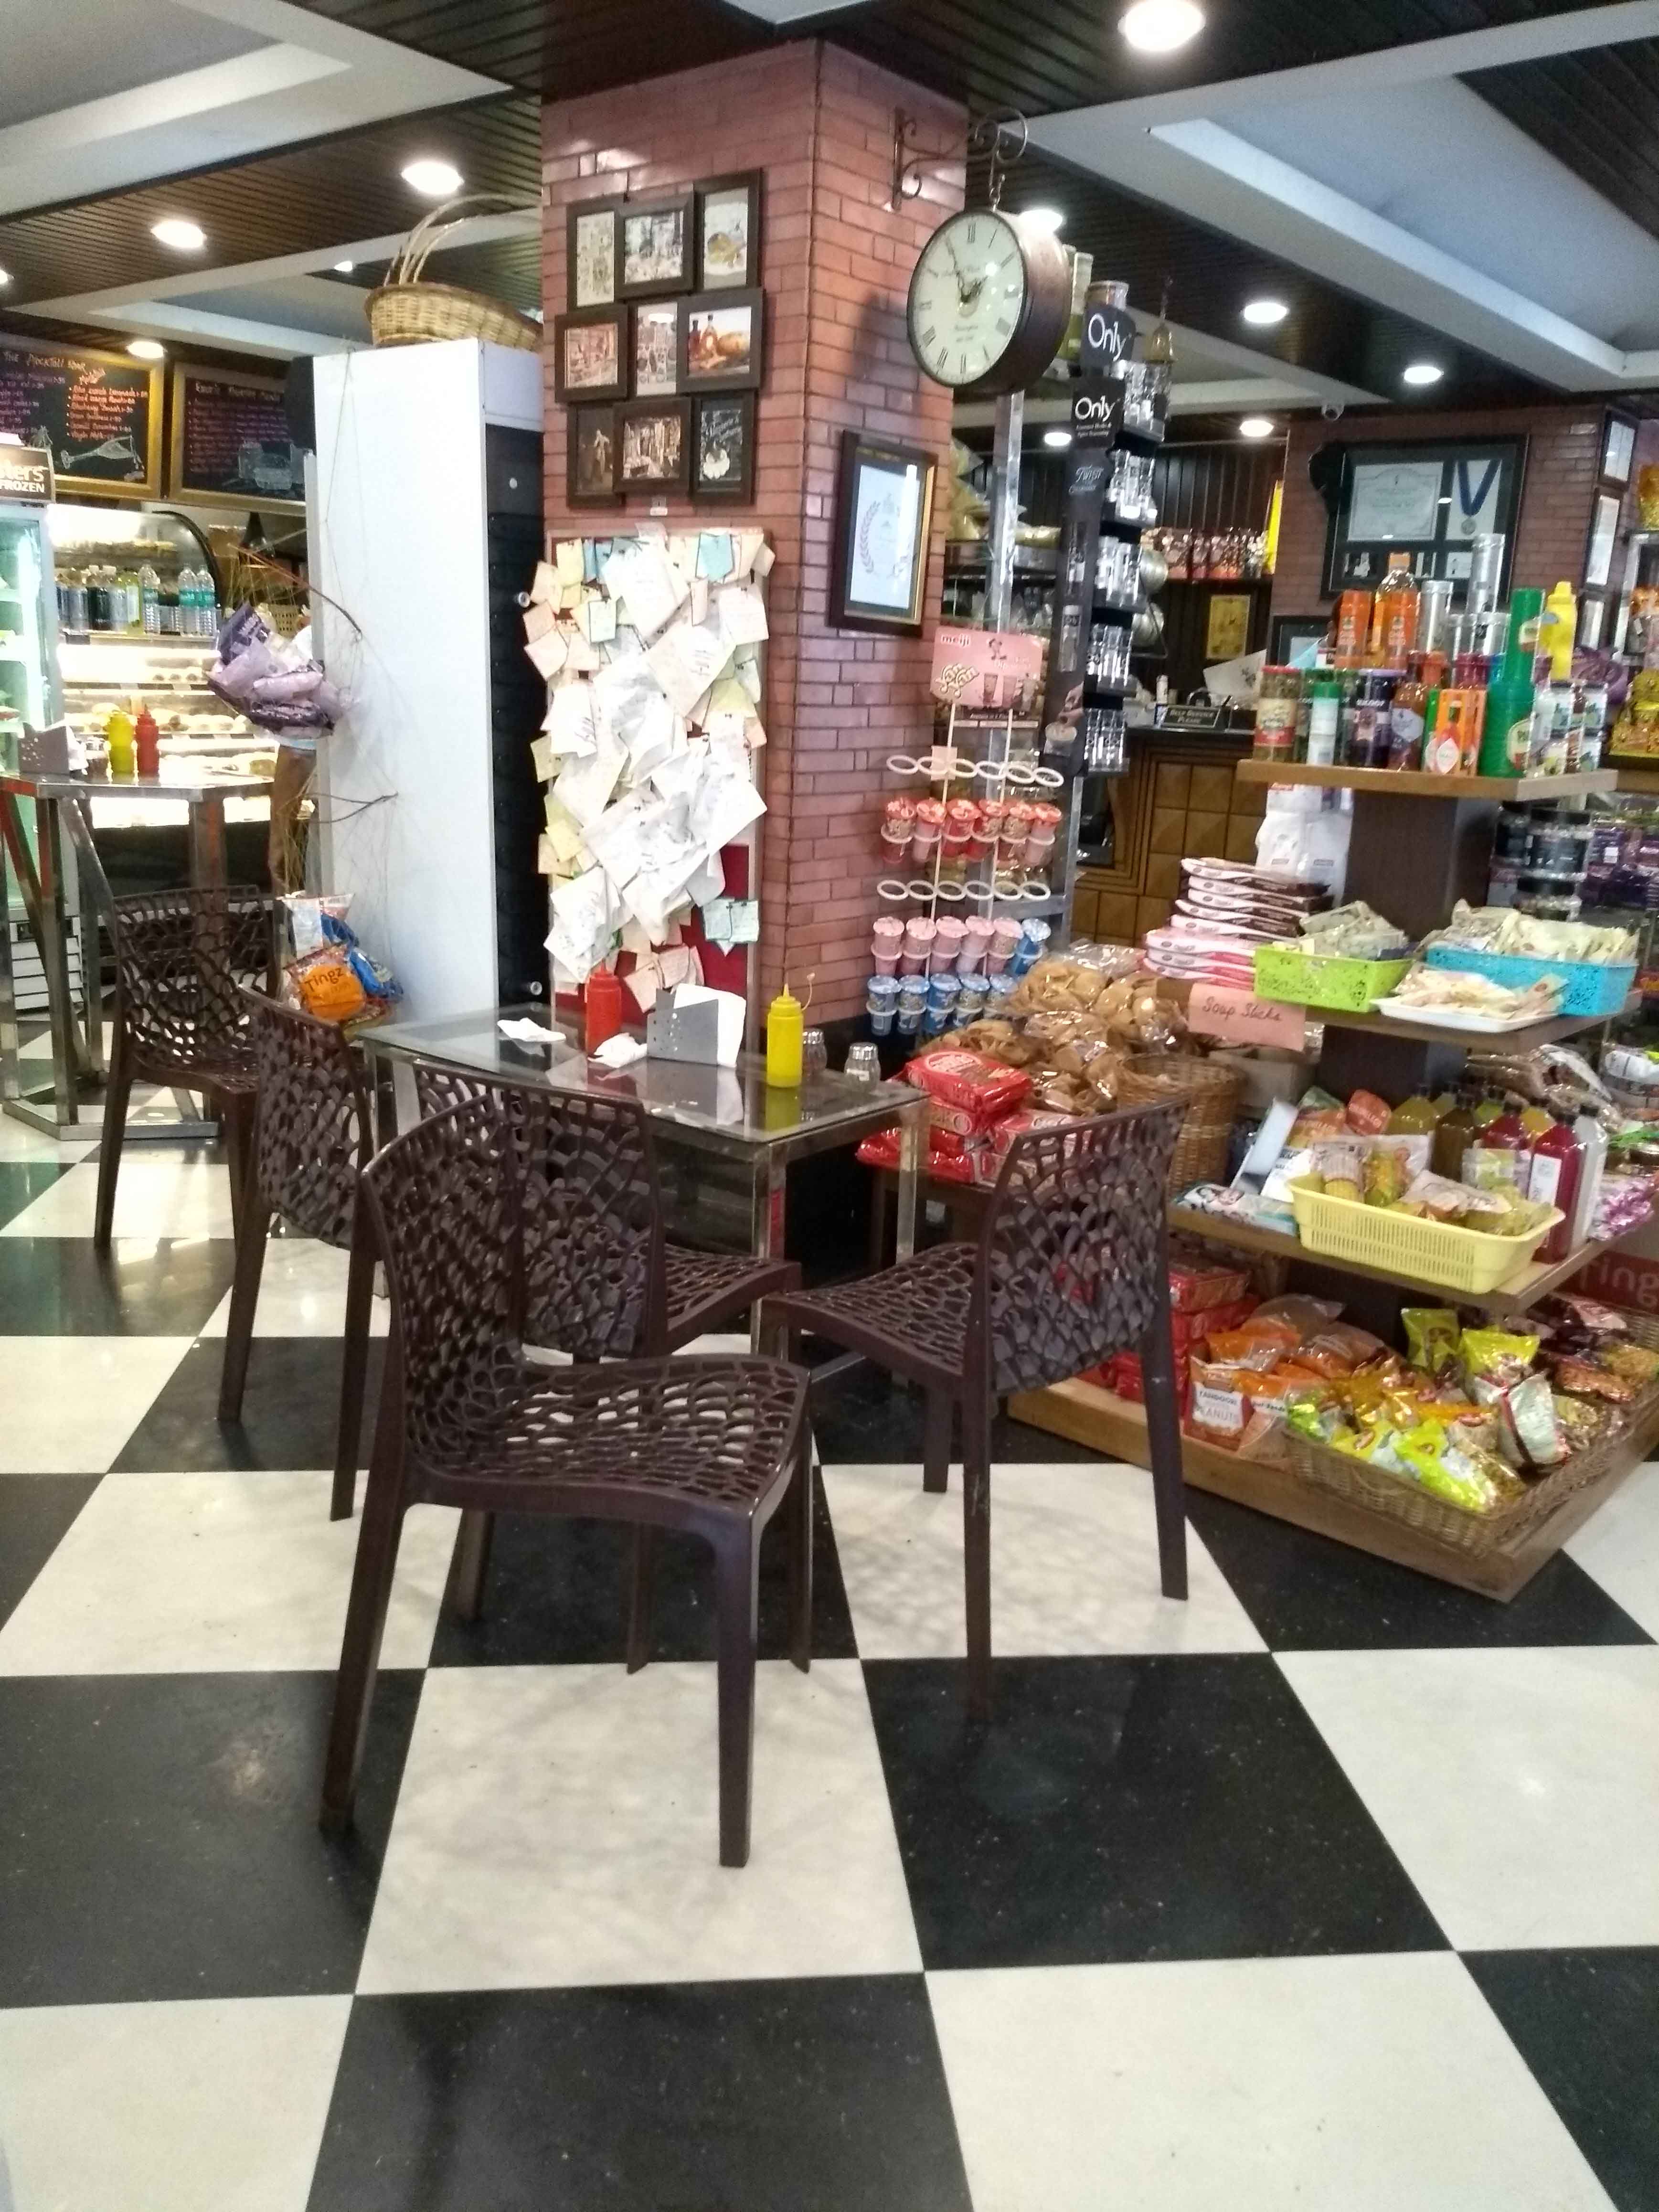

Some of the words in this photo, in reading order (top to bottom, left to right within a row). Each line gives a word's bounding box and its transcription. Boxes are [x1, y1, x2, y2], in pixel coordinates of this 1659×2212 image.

[940, 633, 971, 649] meiji
[305, 968, 344, 992] Tingz
[1202, 996, 1235, 1020] Soup
[1240, 1002, 1281, 1021] Sticks
